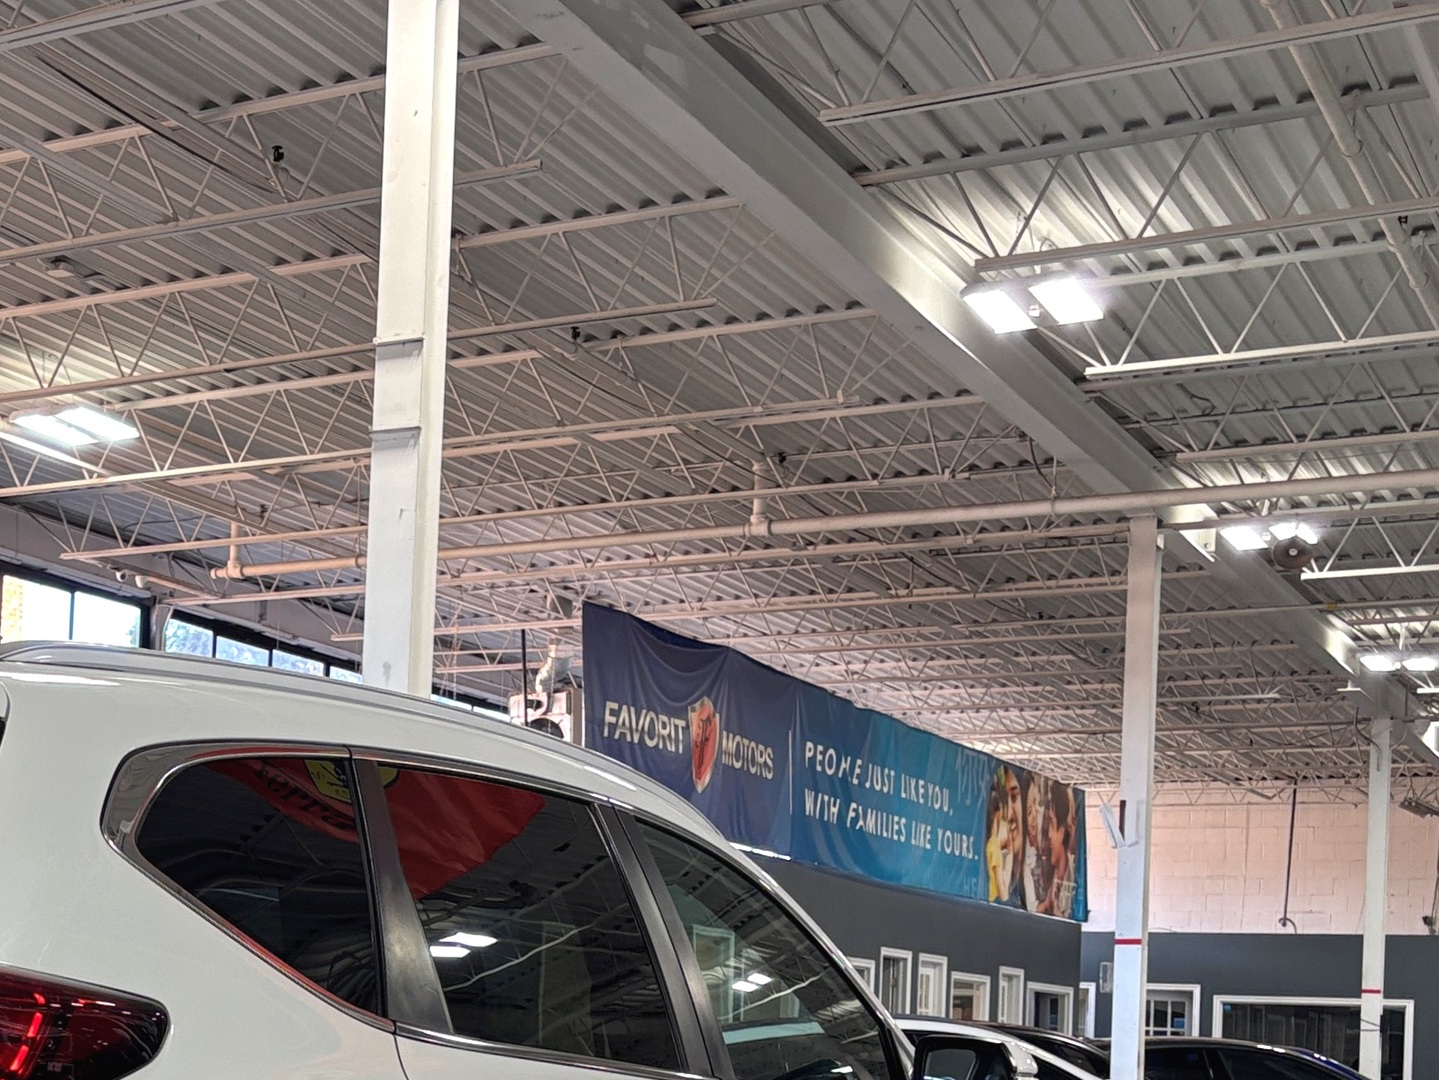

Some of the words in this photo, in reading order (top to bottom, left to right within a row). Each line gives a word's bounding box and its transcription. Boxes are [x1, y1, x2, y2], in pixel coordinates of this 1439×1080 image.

[603, 701, 686, 754] FAVORIT
[722, 730, 774, 780] MOTORS
[804, 788, 840, 825] WITH
[846, 802, 907, 843] FAMILIES
[911, 820, 932, 850] LIKE
[937, 828, 979, 860] YOURS.
[865, 763, 895, 795] JUST
[900, 773, 925, 804] LIKE
[927, 782, 953, 816] YOU,
